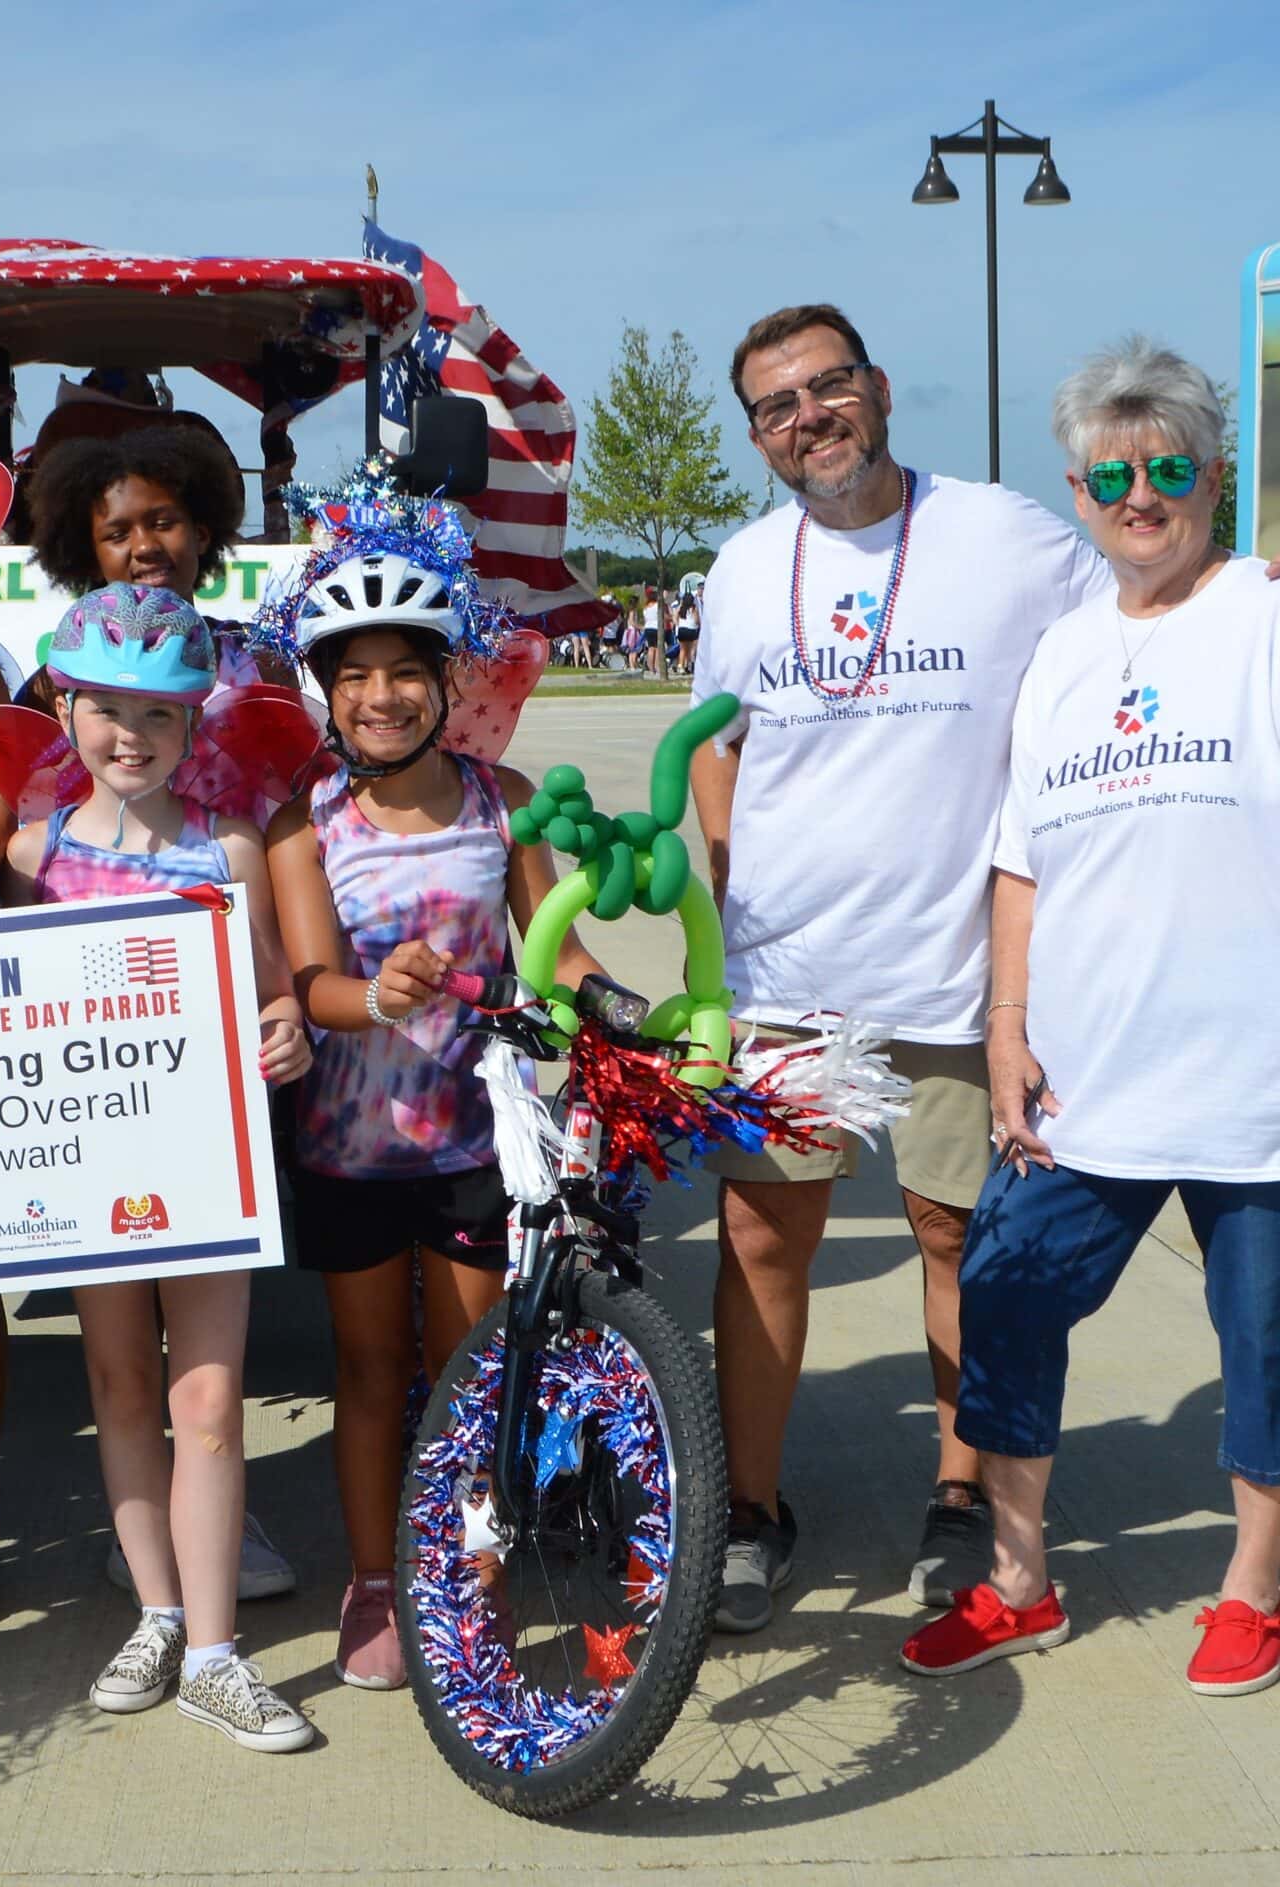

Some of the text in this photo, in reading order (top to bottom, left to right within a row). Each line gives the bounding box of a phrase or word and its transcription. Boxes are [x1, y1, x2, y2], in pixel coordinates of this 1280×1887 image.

[876, 701, 919, 720] Bright
[921, 700, 974, 714] Futures.
[1038, 731, 1234, 796] Midlothian
[1096, 773, 1153, 795] TEXAS
[1031, 791, 1240, 839] Strong Foundations. Bright Futures.
[25, 1001, 70, 1030] DAY
[84, 989, 182, 1024] PARADE
[63, 1036, 187, 1073] Glory
[129, 1232, 153, 1240] PIZZA
